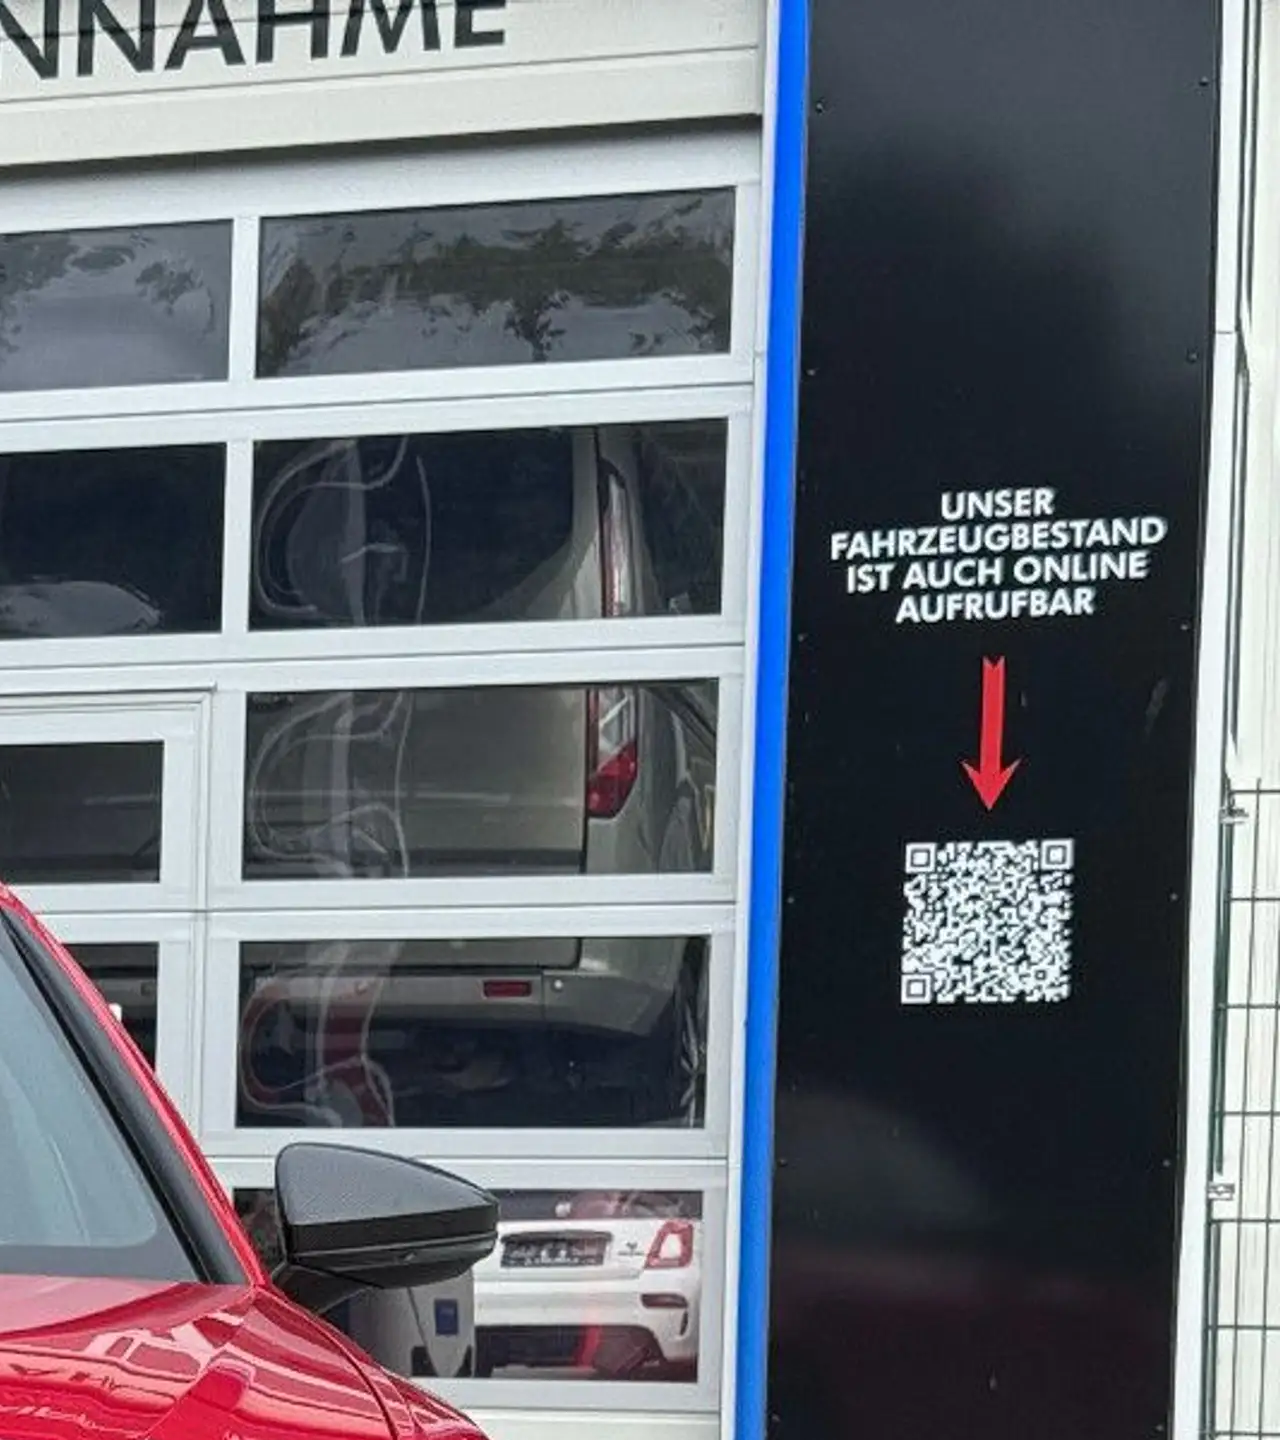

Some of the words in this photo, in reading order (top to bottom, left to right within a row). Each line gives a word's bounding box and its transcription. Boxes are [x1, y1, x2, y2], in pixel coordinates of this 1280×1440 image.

[940, 487, 1055, 520] UNSER
[831, 516, 1167, 560] FAHRZEUGBESTAND
[847, 563, 893, 594] IST
[901, 556, 1003, 590] AUCH
[1013, 551, 1149, 584] ONLINE
[895, 586, 1096, 624] AUFRUFBAR
